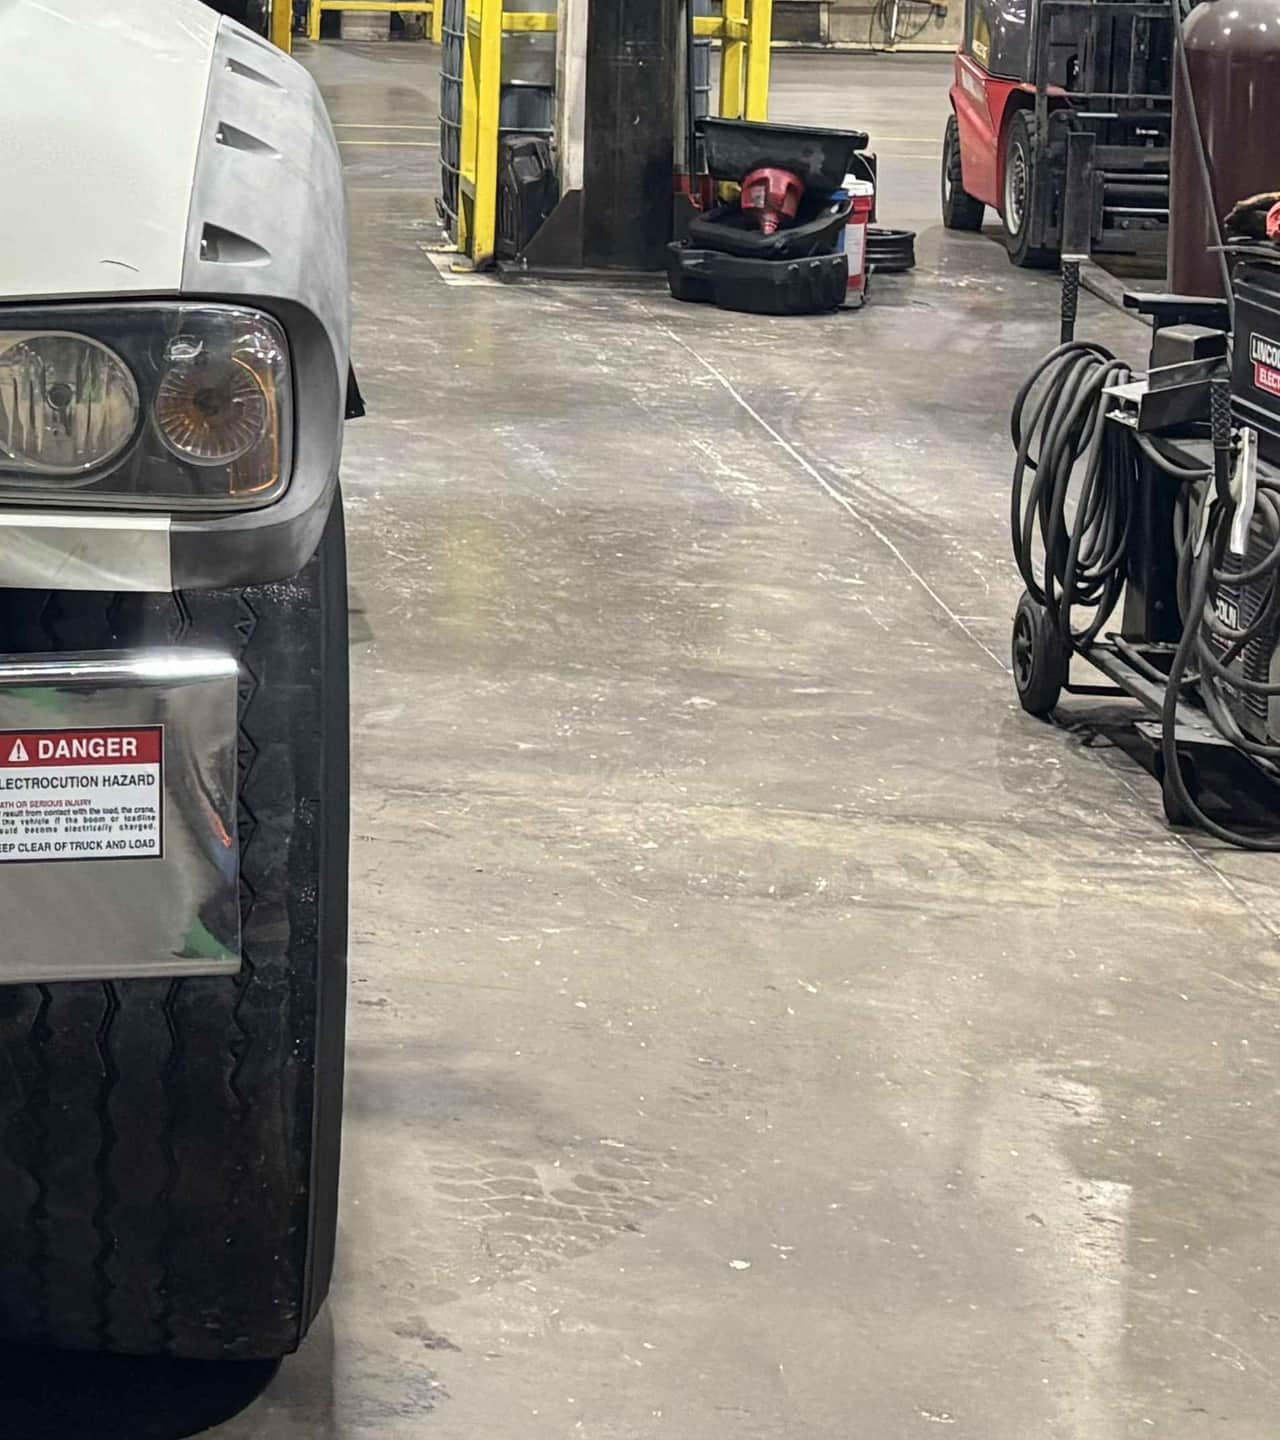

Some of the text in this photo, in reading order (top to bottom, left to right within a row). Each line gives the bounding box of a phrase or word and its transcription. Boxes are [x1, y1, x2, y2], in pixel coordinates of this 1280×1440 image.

[38, 737, 137, 759] DANGER
[102, 774, 155, 787] HAZARD
[16, 800, 28, 809] OR
[29, 799, 63, 808] SERIOUS
[64, 799, 91, 807] INJURY
[3, 809, 24, 818] result
[25, 809, 42, 817] from
[44, 808, 70, 816] contact
[89, 807, 101, 815] the
[20, 817, 49, 825] vehicle
[65, 816, 78, 824] the
[83, 815, 106, 823] boom
[24, 826, 58, 834] become
[64, 824, 112, 833] electrically
[18, 842, 51, 852] CLEAR
[54, 841, 67, 851] OF
[70, 840, 103, 851] TRUCK
[105, 839, 126, 850] AND
[129, 839, 155, 849] LOAD
